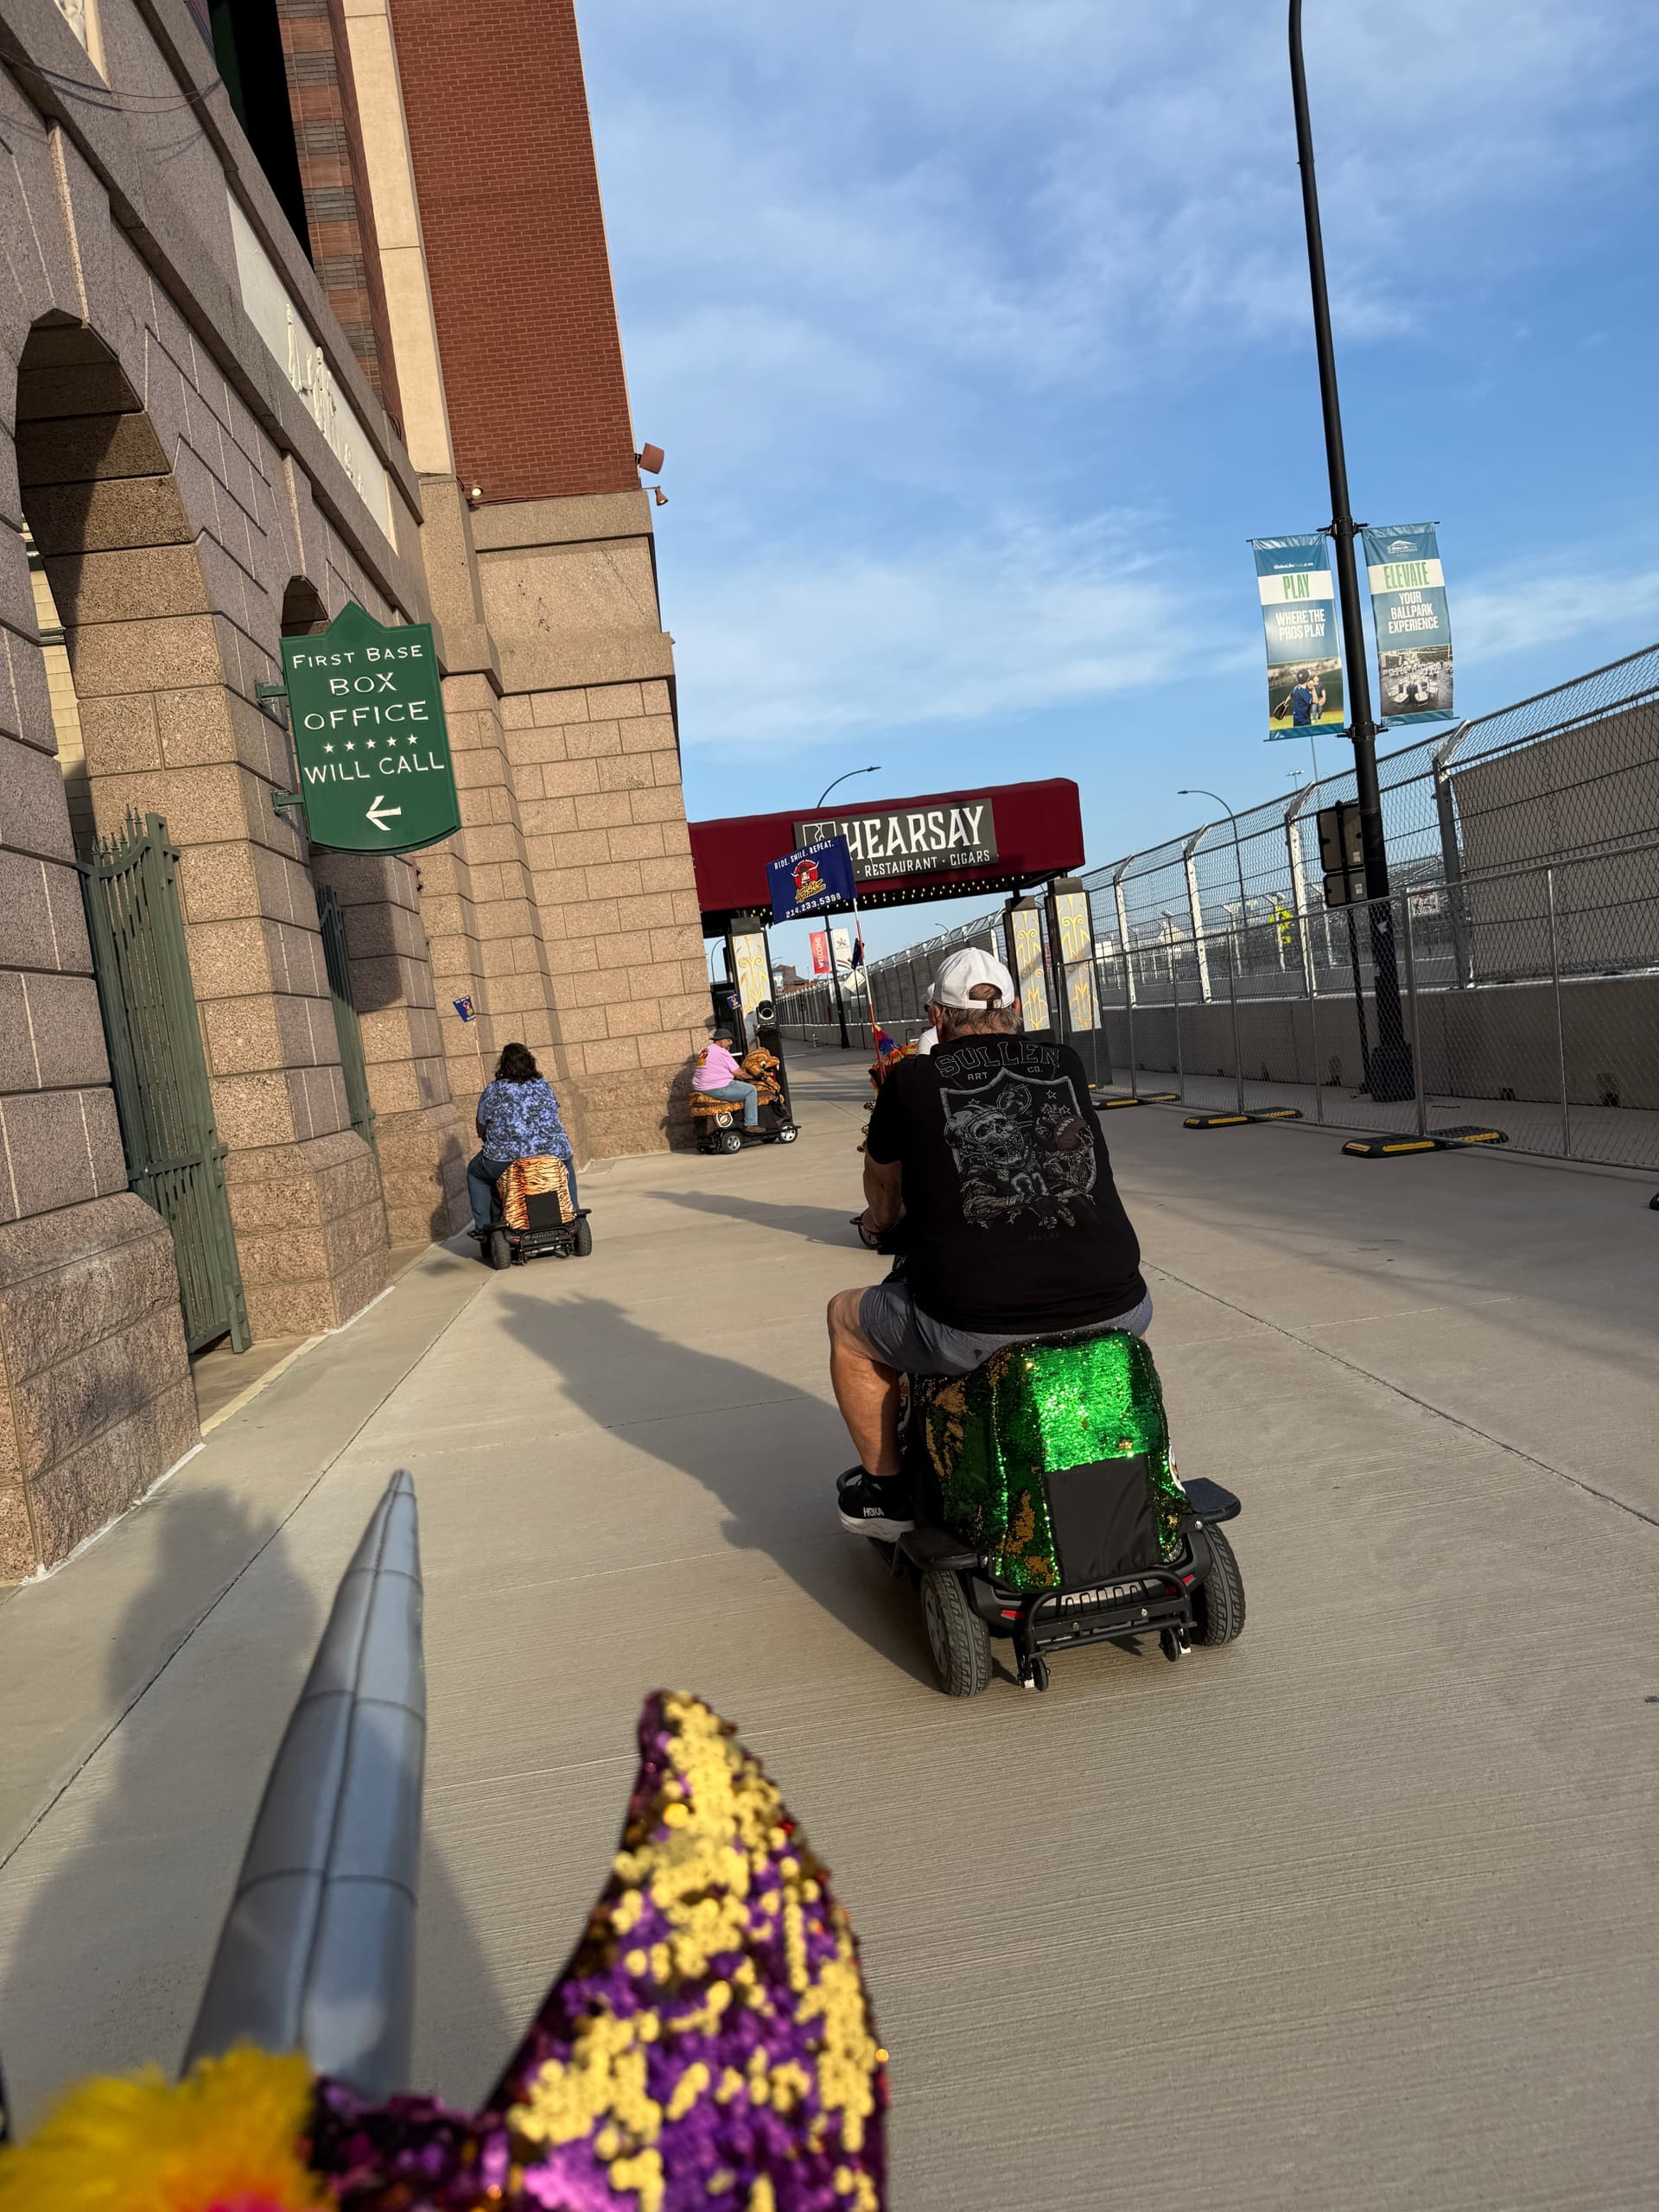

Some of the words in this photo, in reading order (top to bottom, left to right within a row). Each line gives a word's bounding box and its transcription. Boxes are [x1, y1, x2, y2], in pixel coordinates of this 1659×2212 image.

[1282, 574, 1310, 600] PLAY
[1383, 562, 1430, 589] ELEVATE
[1399, 591, 1422, 605] YOUR
[1275, 609, 1308, 626] WHERE
[1308, 608, 1326, 623] THE
[1390, 603, 1434, 620] BALLPARK
[1279, 625, 1304, 642] PROS
[1304, 623, 1325, 638] PLAY
[1388, 616, 1439, 634] EXPERIENCE
[292, 652, 355, 670] FIRST
[366, 645, 423, 662] BASE
[329, 672, 397, 696] BOX
[304, 700, 429, 730] OFFICE
[304, 760, 370, 785] WILL
[379, 752, 445, 775] CALL
[841, 805, 984, 861] HEARSAY
[774, 859, 791, 870] RIDE.
[790, 849, 809, 863] SMILE.
[809, 840, 835, 855] REPEAT.
[864, 856, 938, 877] RESTAURANT
[950, 850, 990, 866] CIGARS
[785, 893, 842, 918] 214.233.5398
[815, 937, 825, 969] WELCOME
[935, 1041, 1060, 1077] SULLEN
[968, 1071, 988, 1081] ART
[863, 1507, 885, 1517] HOKA
